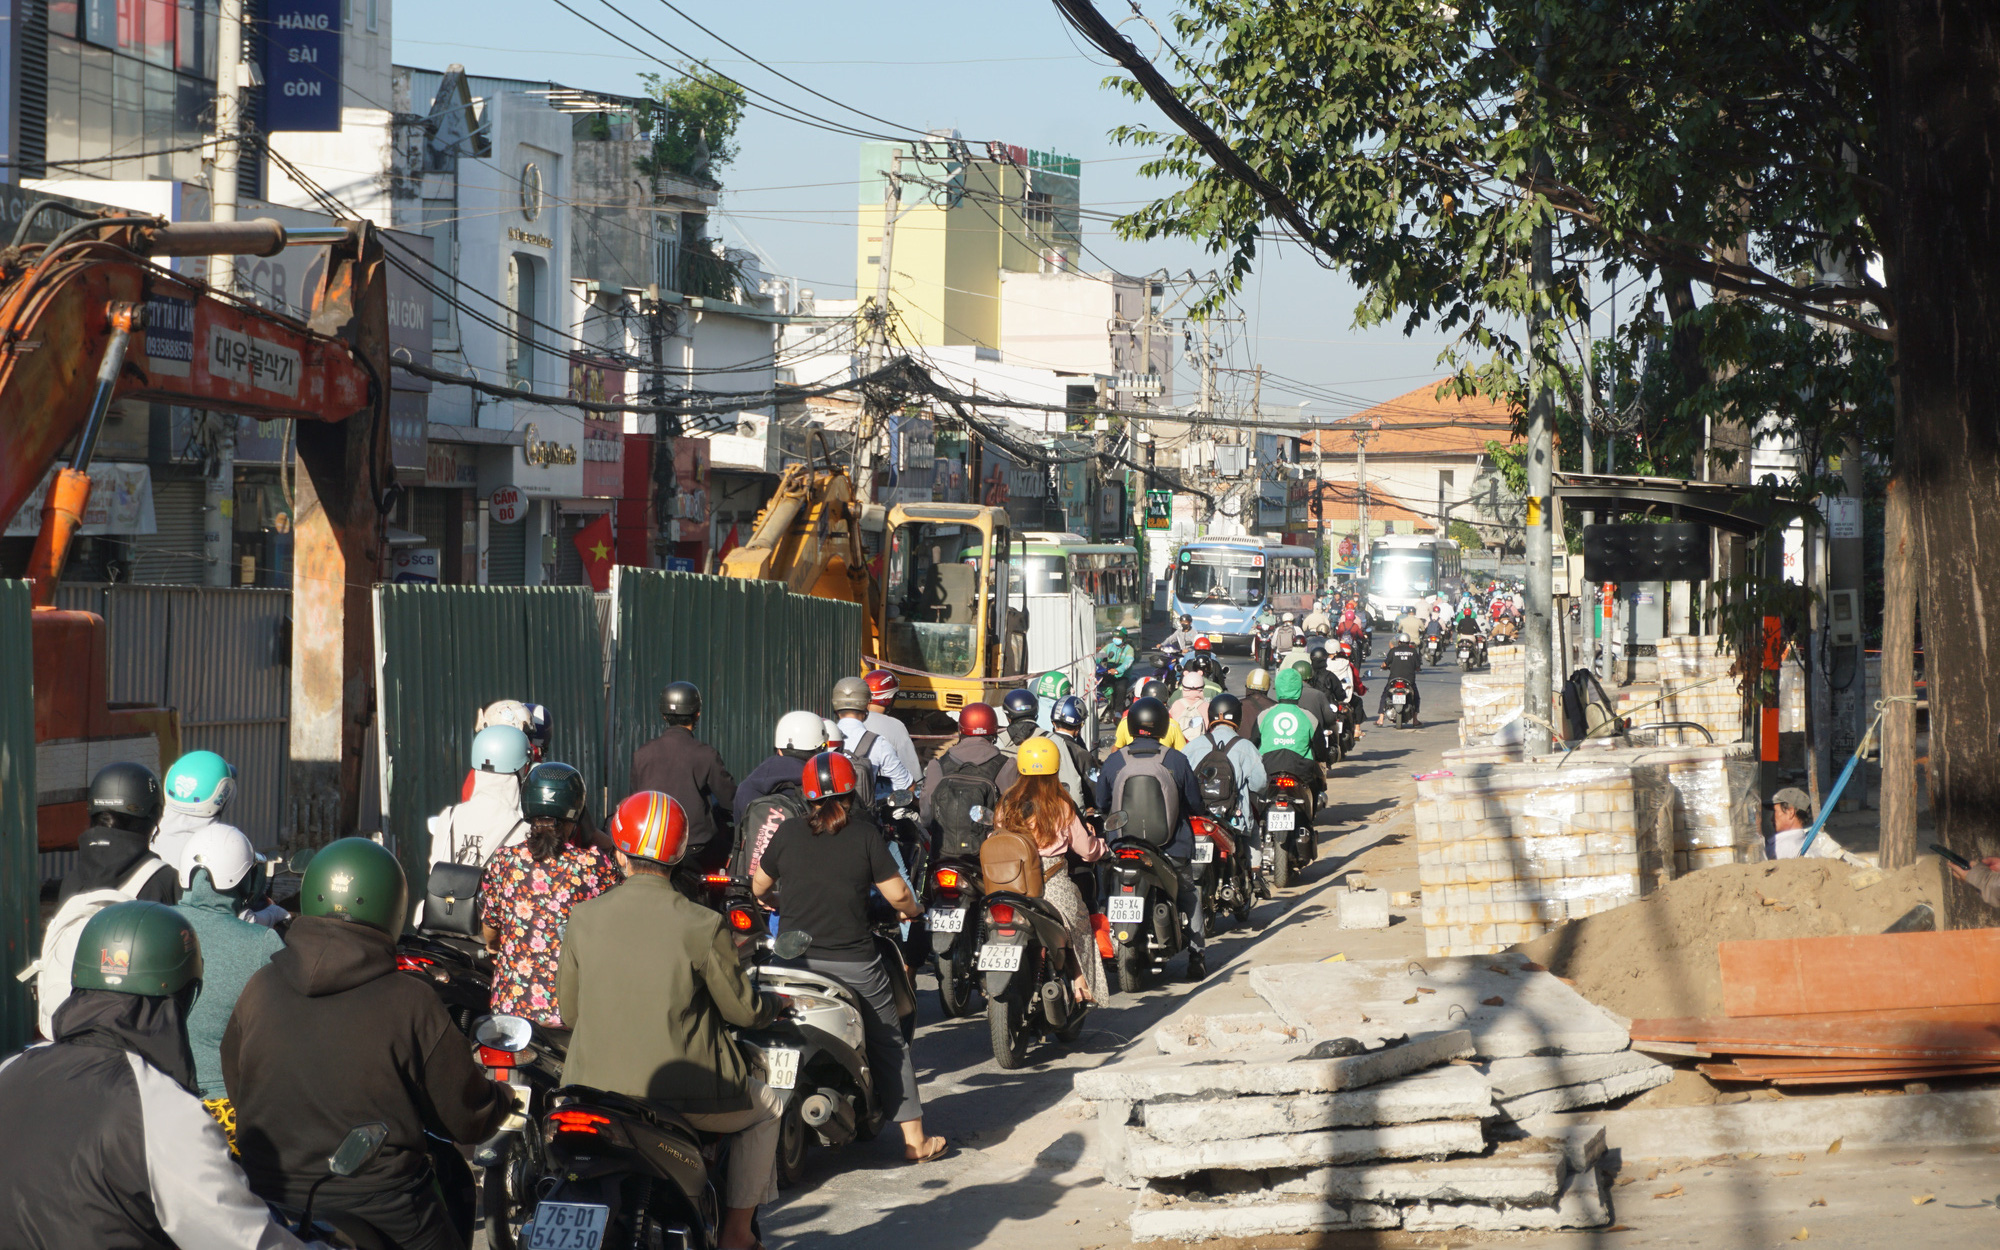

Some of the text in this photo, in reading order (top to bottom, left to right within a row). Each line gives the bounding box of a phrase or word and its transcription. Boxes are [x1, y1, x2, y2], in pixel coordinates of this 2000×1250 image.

[279, 13, 329, 30] HÀNG
[288, 45, 318, 63] SÀI
[283, 79, 322, 97] GÒN
[163, 297, 179, 330] TÂY
[387, 293, 424, 331] ÀI GÒN
[215, 334, 293, 386] 대우굴삭기
[1046, 450, 1058, 504] MZZOLA
[411, 555, 434, 565] SCB
[1254, 555, 1262, 566] 8
[1273, 737, 1295, 746] gojek
[1113, 899, 1139, 909] 59-X4
[1110, 910, 1141, 920] 206.30
[933, 920, 962, 930] 54.83
[987, 946, 1016, 957] 72-F1
[980, 958, 1019, 969] 645.83
[545, 1206, 595, 1228] 76-D1
[533, 1227, 599, 1250] 547.50
